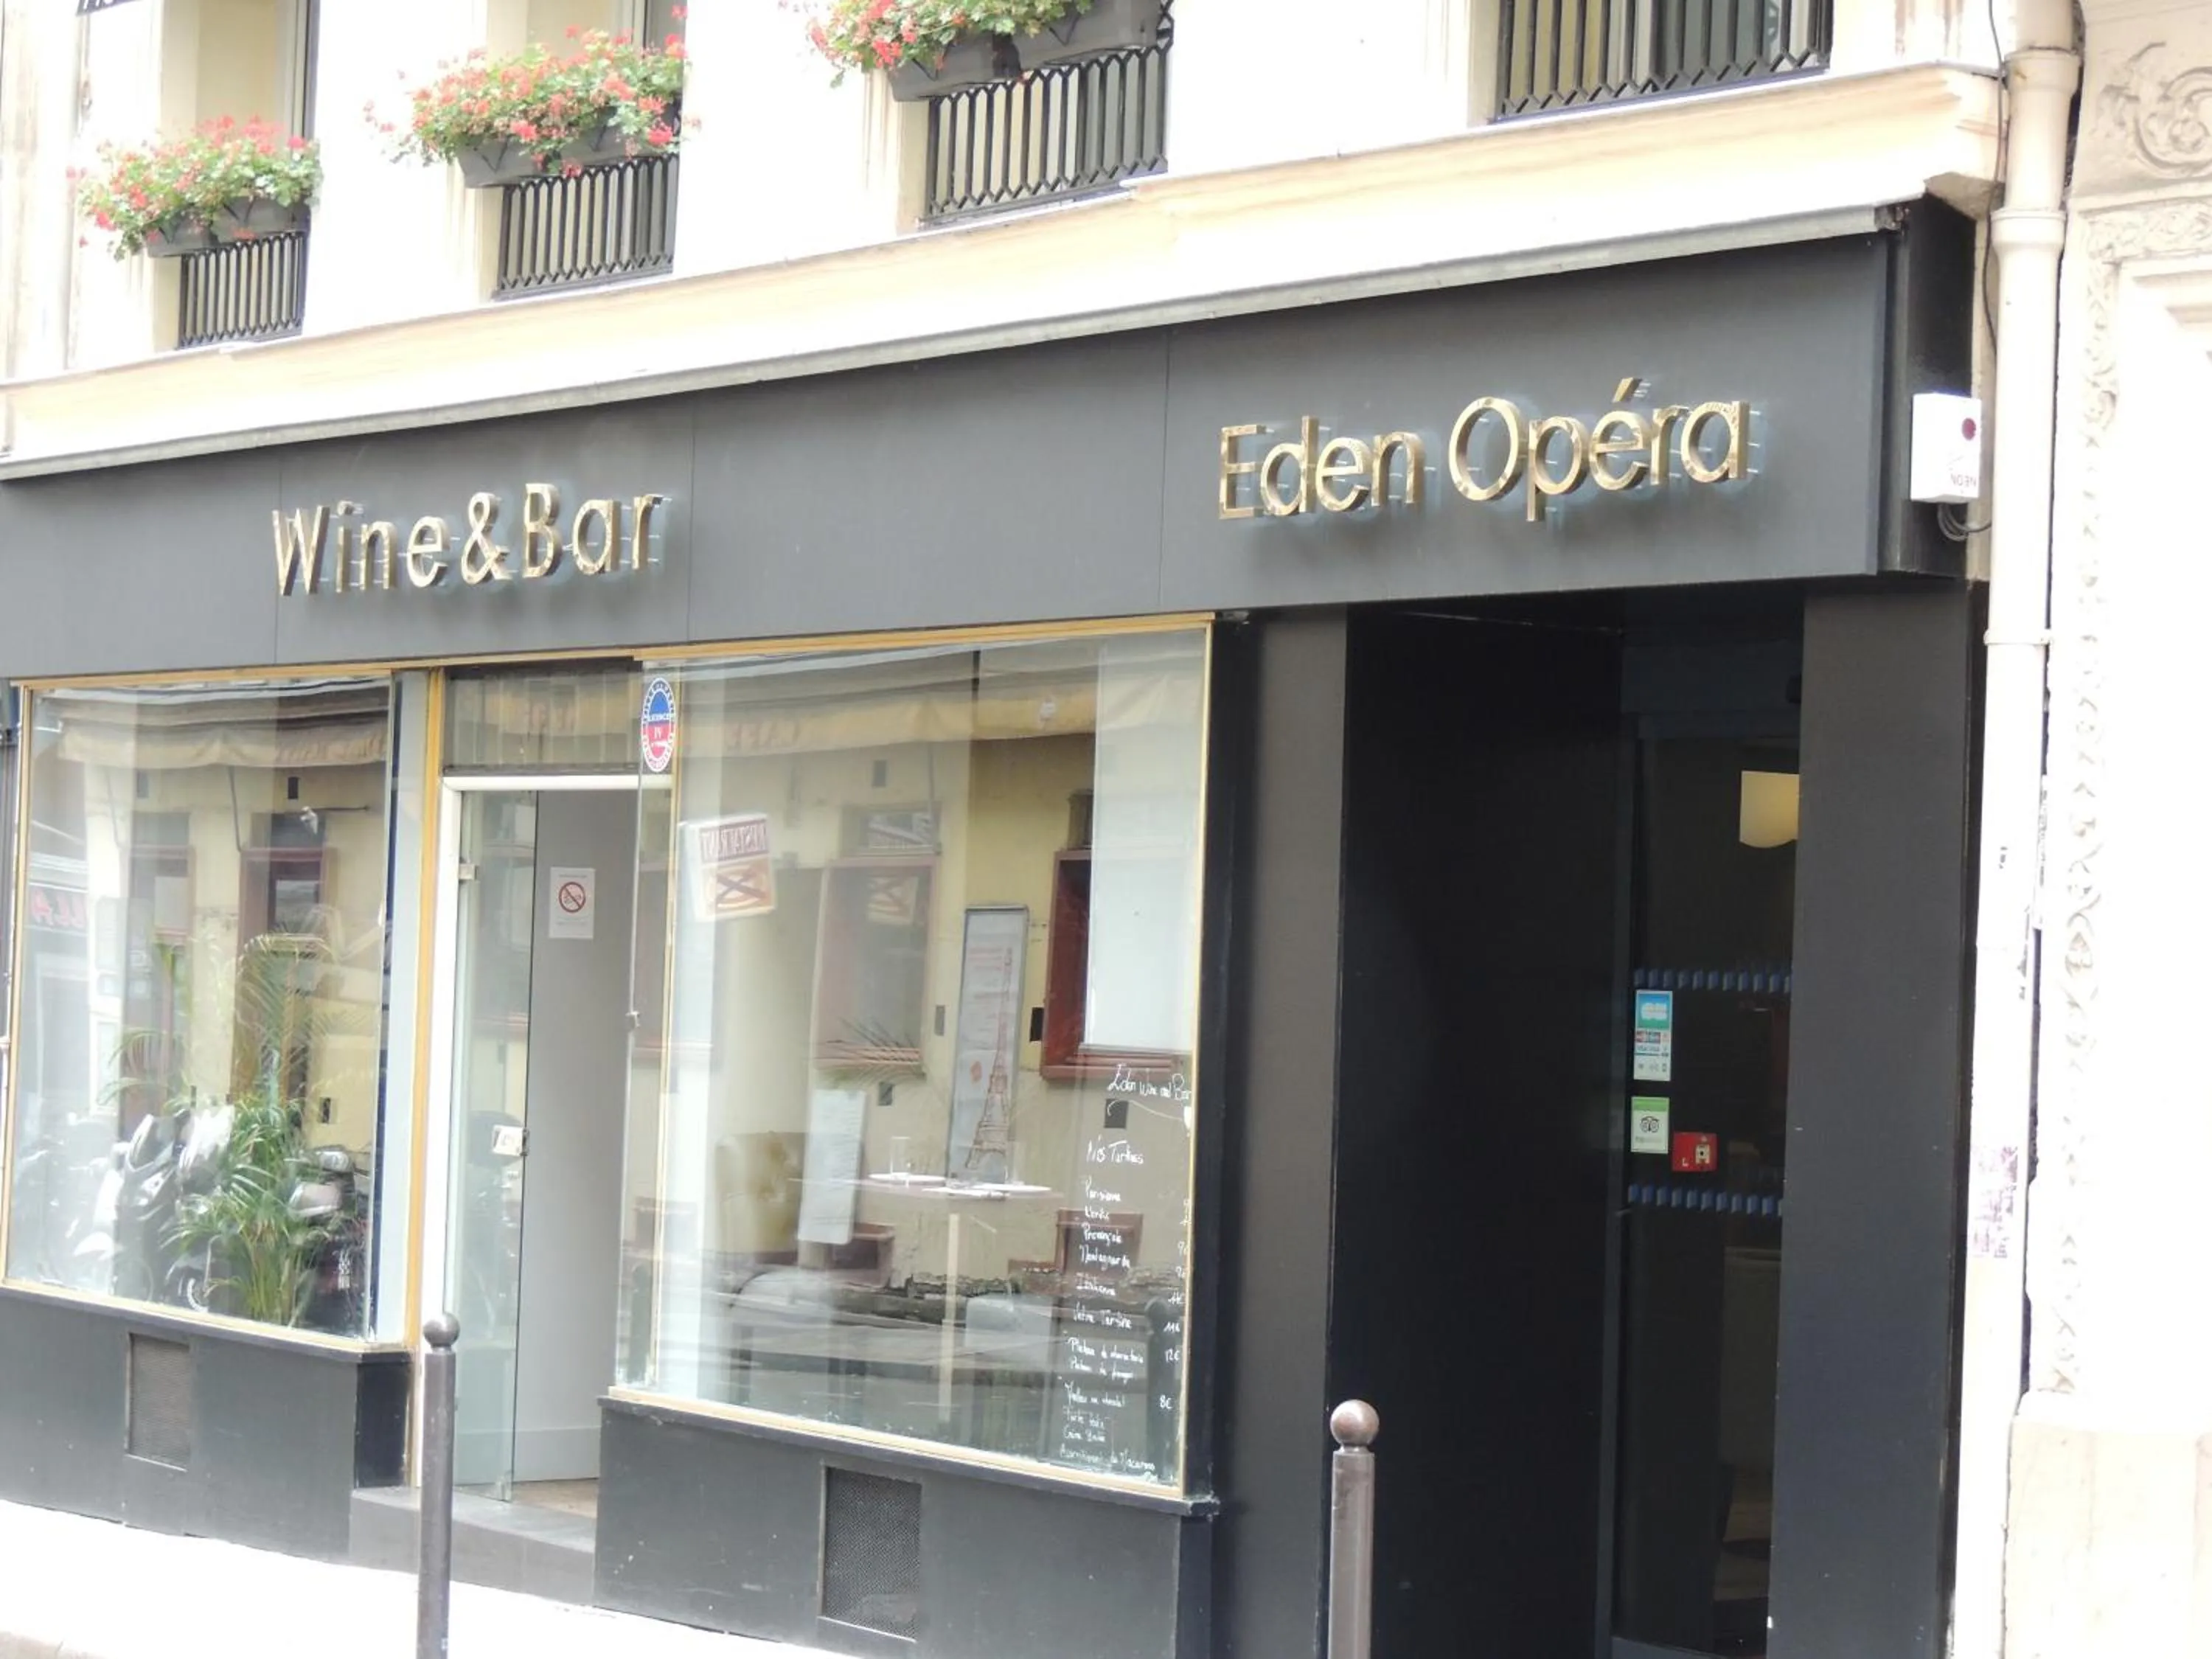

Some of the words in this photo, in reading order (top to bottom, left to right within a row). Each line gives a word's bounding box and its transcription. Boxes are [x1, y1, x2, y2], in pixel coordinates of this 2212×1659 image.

[1219, 416, 1425, 519] Eden
[1448, 378, 1750, 521] Opéra
[272, 500, 449, 597] Wine
[461, 492, 512, 585] &
[522, 483, 663, 579] Bar
